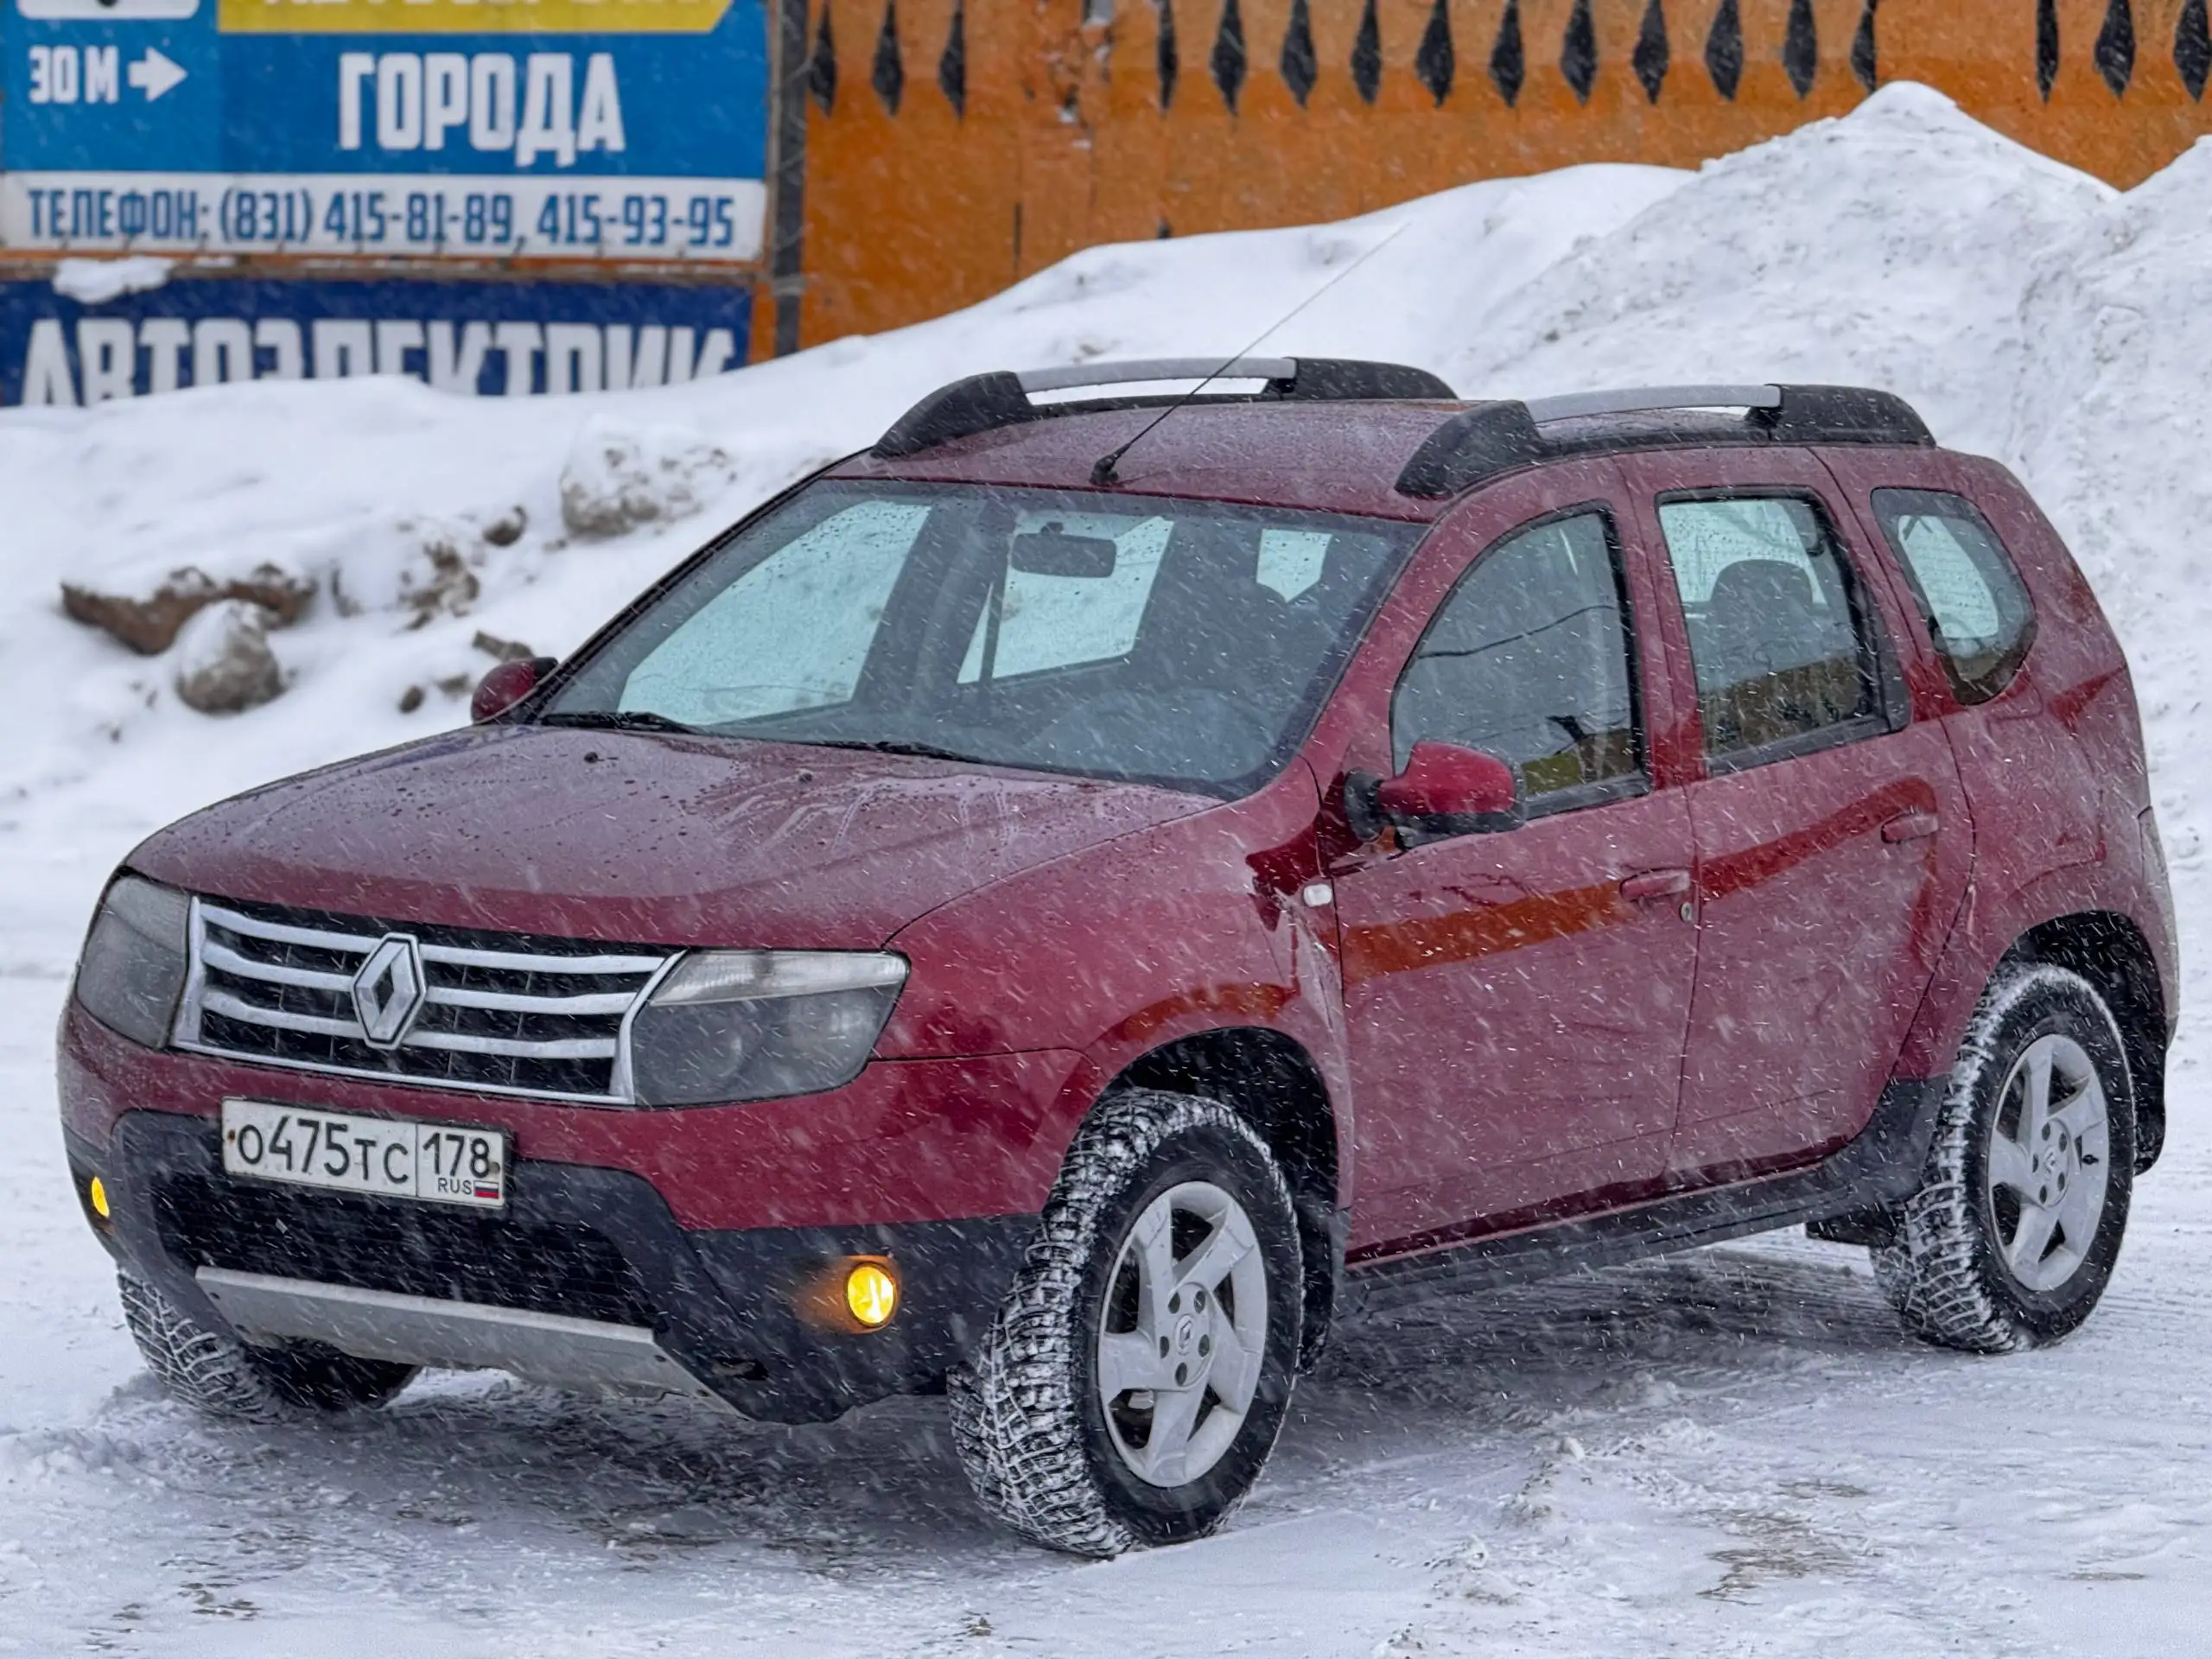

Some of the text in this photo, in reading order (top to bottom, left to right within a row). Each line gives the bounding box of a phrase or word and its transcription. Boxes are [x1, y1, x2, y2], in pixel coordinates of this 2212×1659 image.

[340, 53, 626, 167] ГОРОДА
[29, 189, 210, 239] ТЕЛЕФОН:
[220, 188, 313, 243] (831)
[537, 194, 734, 247] 415-93-95
[423, 1132, 490, 1179] 178
[437, 1177, 473, 1196] RUS
